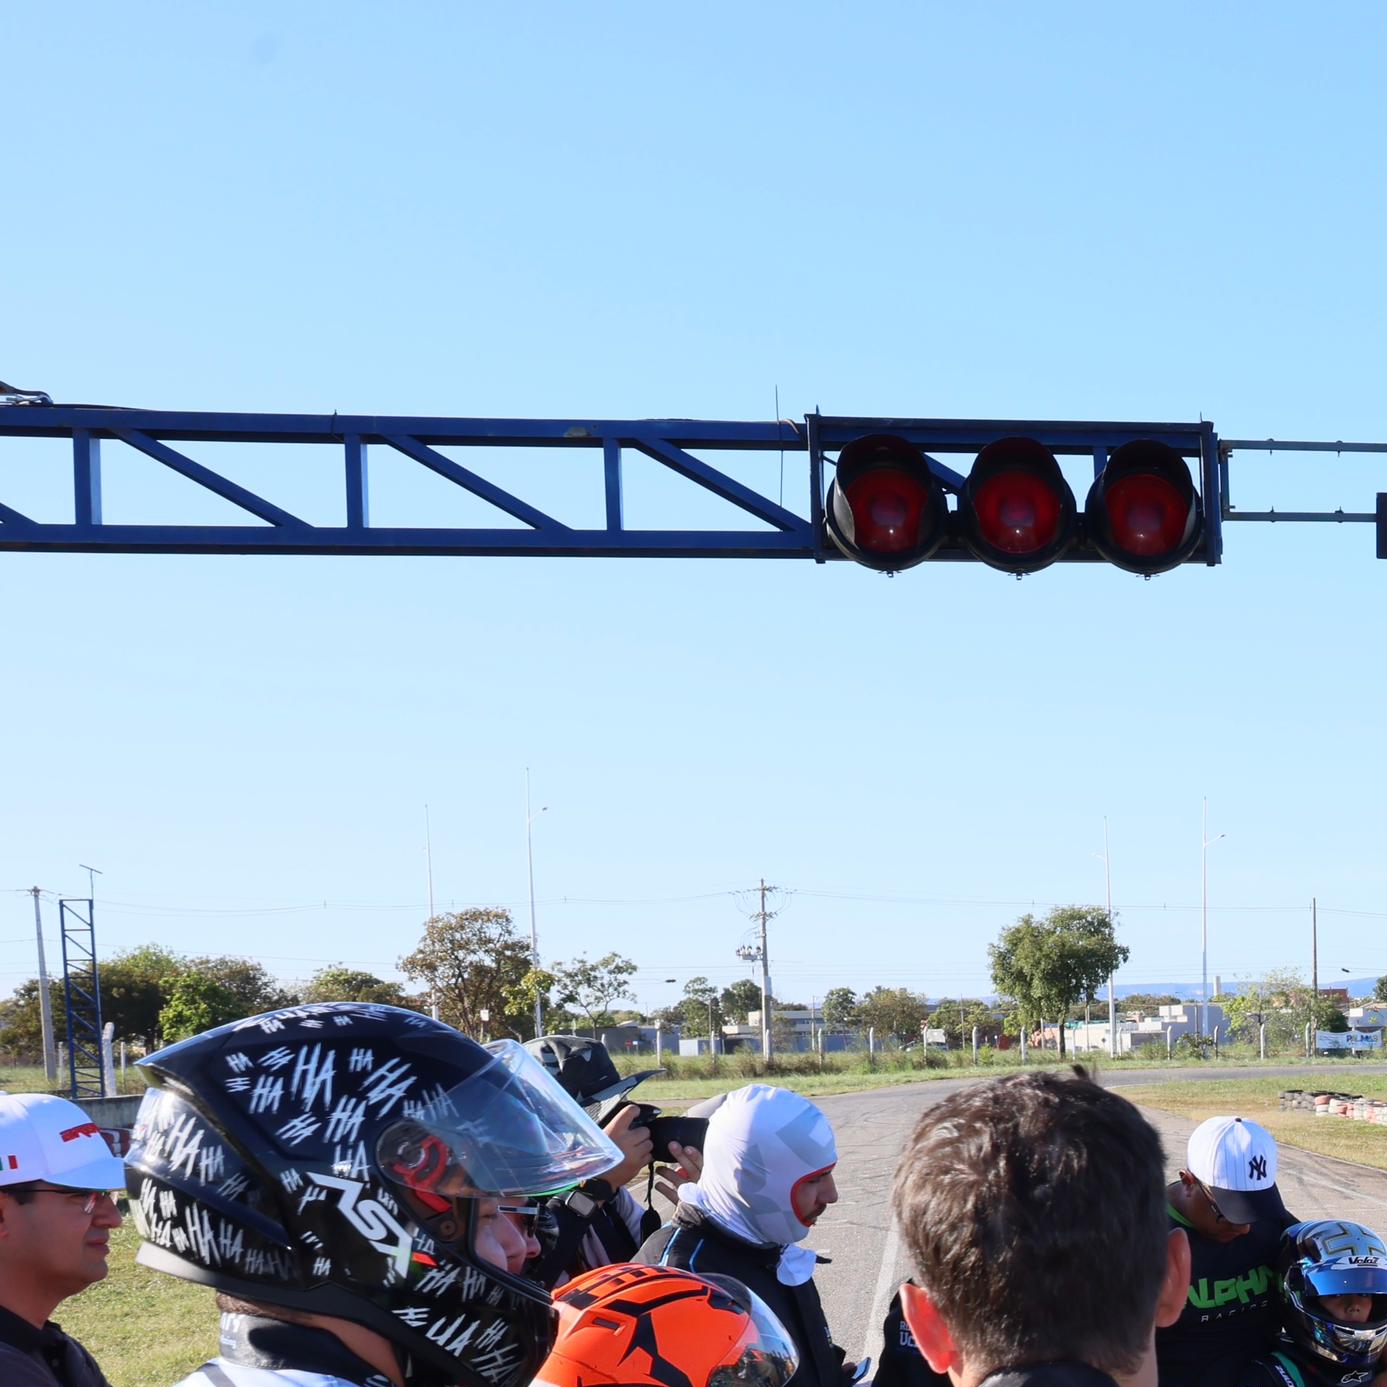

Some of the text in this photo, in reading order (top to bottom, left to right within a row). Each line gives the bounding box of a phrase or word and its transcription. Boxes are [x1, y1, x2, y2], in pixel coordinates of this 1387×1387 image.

[291, 1043, 336, 1112] HA
[350, 1048, 374, 1072] HA
[250, 1075, 284, 1114] HA
[323, 1095, 368, 1143] HA
[1248, 1154, 1268, 1181] NY
